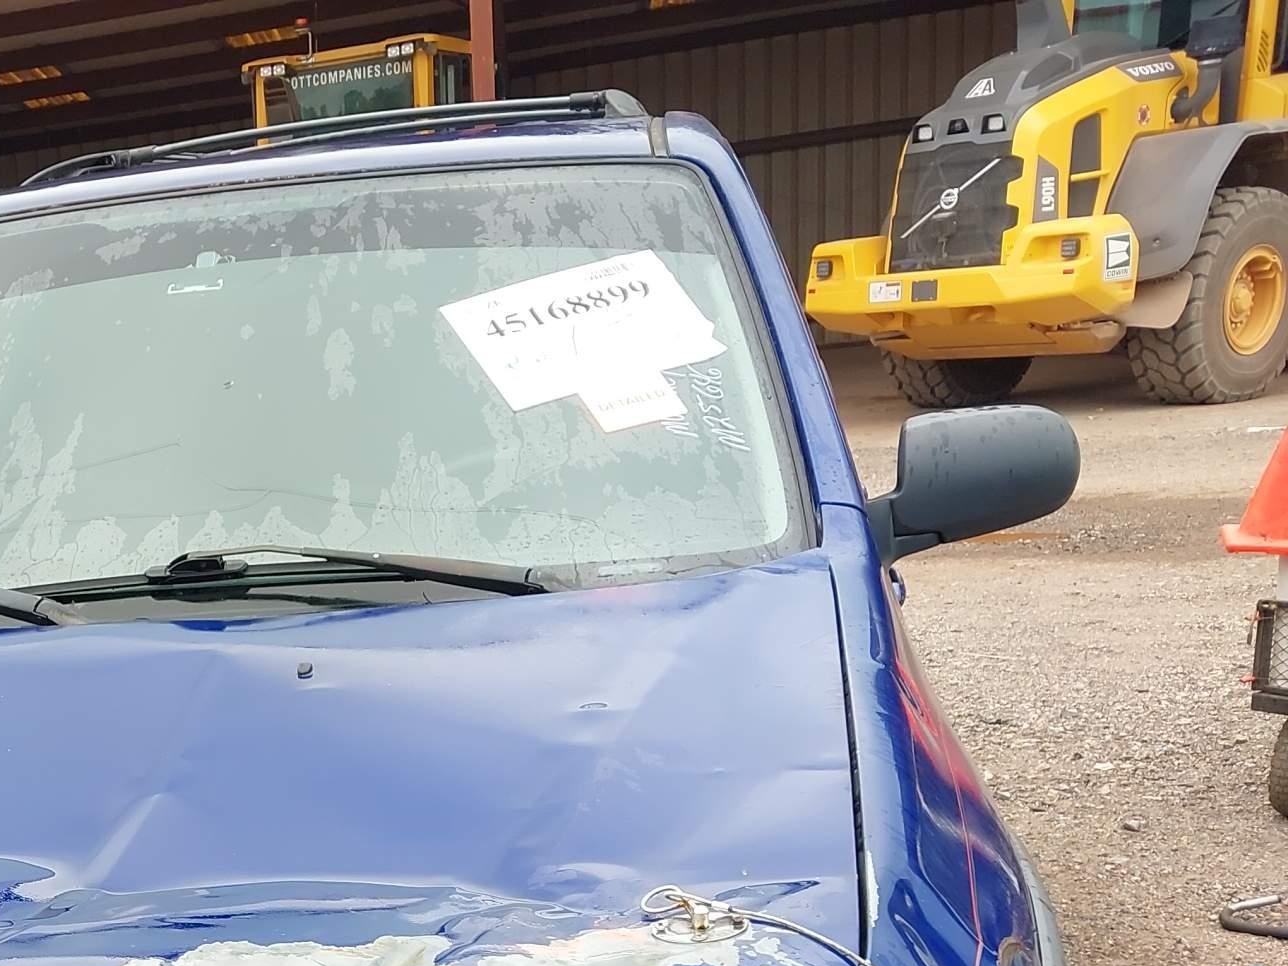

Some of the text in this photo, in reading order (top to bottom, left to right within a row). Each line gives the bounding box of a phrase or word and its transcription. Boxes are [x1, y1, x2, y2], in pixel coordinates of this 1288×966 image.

[286, 60, 413, 90] OTTCOMPANIES.COM
[1125, 61, 1175, 77] VOLVO
[1041, 176, 1056, 212] L90H
[486, 280, 650, 337] 45168899
